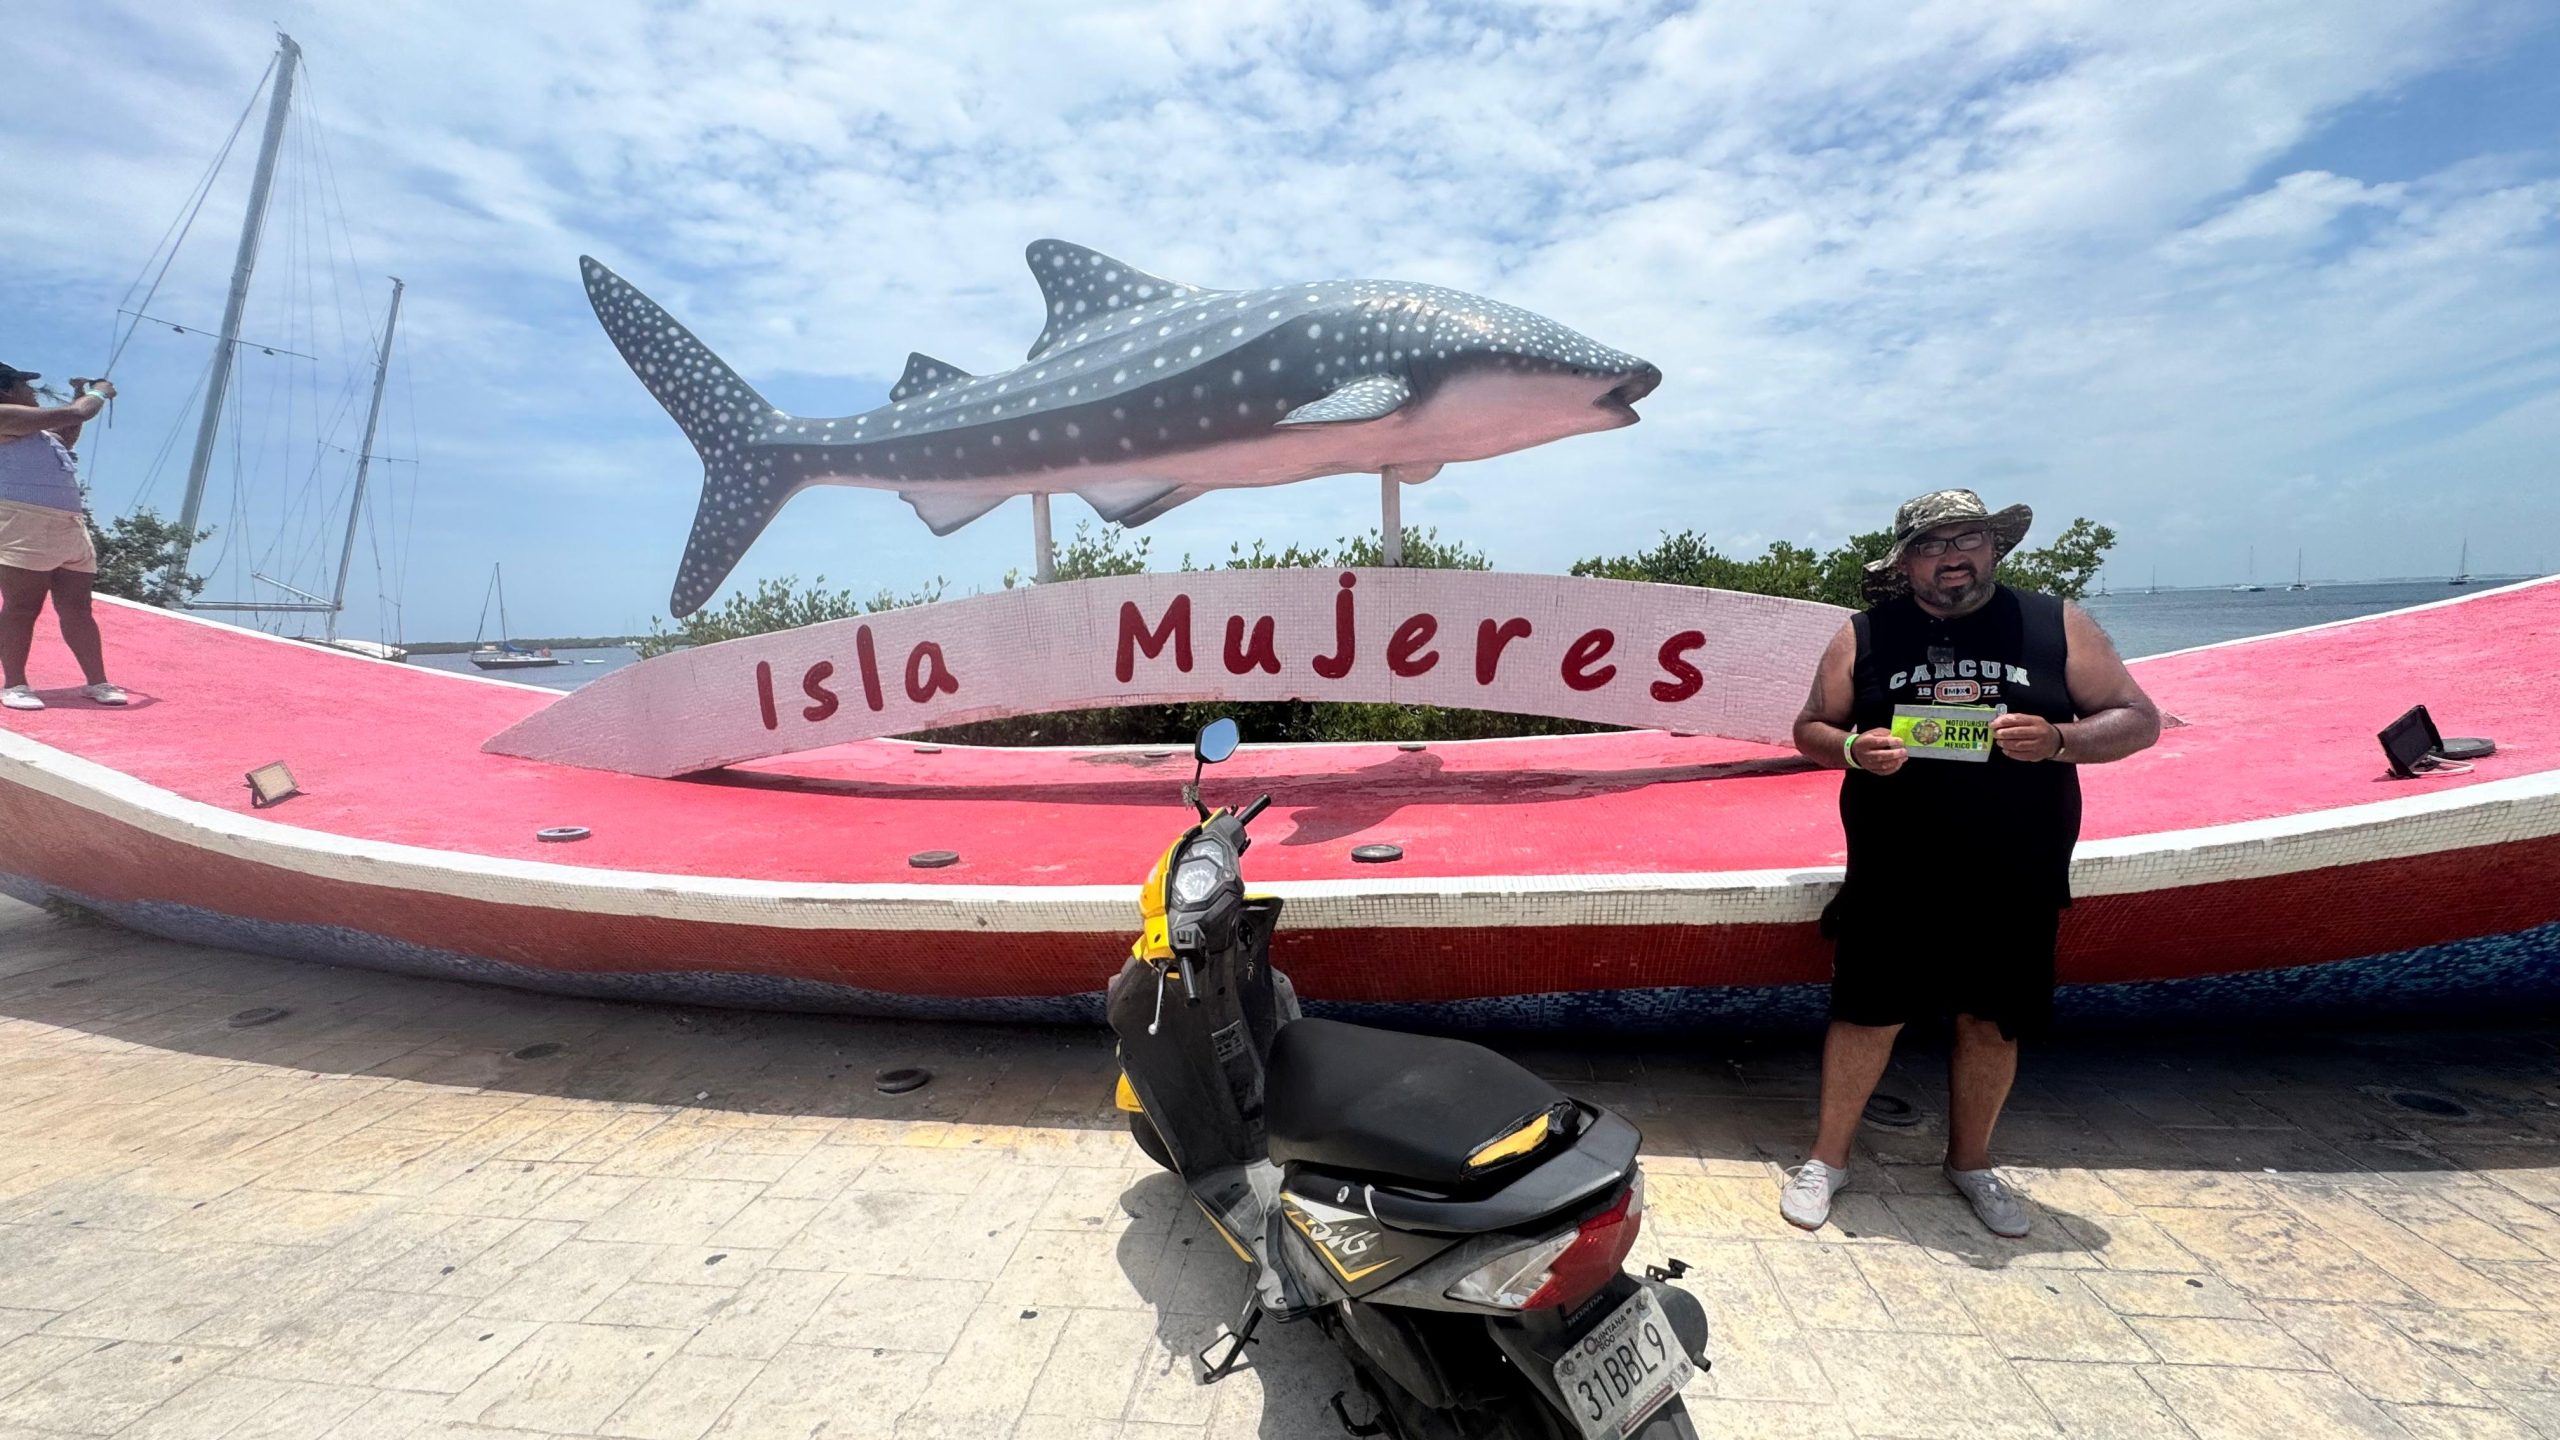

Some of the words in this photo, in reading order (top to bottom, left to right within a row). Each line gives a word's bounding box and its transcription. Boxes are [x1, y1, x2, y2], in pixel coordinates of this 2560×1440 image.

[757, 624, 959, 730] Isla
[1115, 571, 1707, 703] Mujeres
[1889, 659, 2031, 690] CANCUN
[1917, 687, 1932, 696] 19
[1981, 685, 1999, 695] 72
[1944, 726, 1989, 742] RRM
[1945, 719, 1989, 728] MOTOTURISTA
[1583, 1314, 1627, 1356] QUINTANA
[1600, 1335, 1616, 1352] ROO
[1578, 1321, 1666, 1422] 31BBL9
